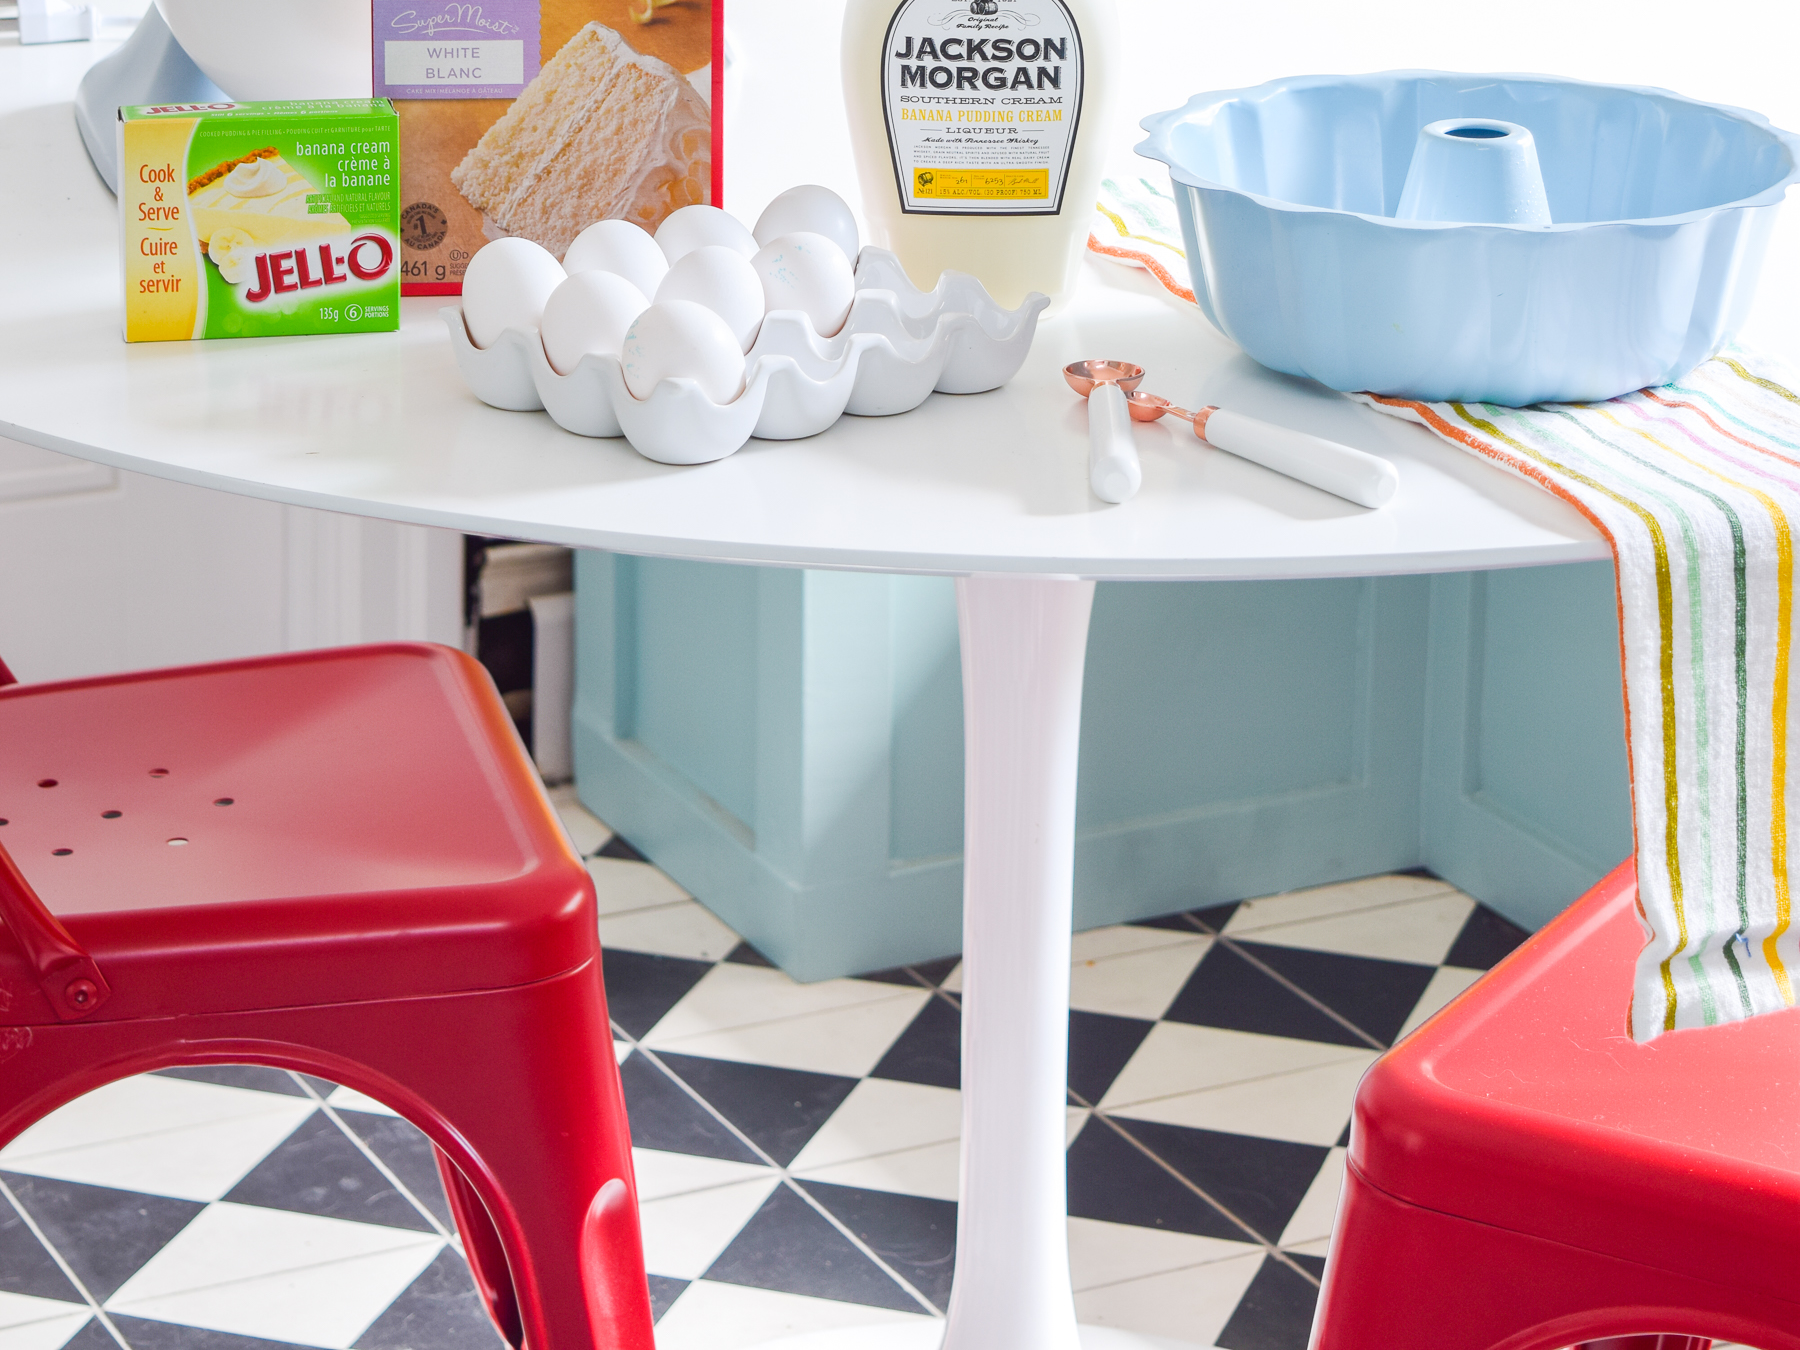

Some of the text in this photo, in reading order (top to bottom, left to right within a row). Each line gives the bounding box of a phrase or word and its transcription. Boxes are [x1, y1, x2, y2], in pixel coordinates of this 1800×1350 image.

[967, 16, 998, 24] Original
[427, 47, 480, 59] WHITE
[895, 36, 1067, 63] JACKSON
[425, 67, 482, 79] BLANC
[900, 64, 1062, 91] MORGAN
[900, 95, 1063, 105] SOUTHERN CREAM
[146, 103, 235, 115] JELL-O
[901, 108, 1063, 123] BANANA PUDDING CREAM
[945, 127, 1019, 135] LIQUEUR
[296, 141, 390, 156] banana cream
[337, 155, 390, 171] crème à
[139, 163, 175, 183] Cook
[325, 173, 390, 188] la banane
[154, 186, 164, 202] &
[345, 193, 368, 202] NATURAL
[368, 192, 391, 201] FLAVOUR
[138, 202, 180, 221] Serve
[359, 203, 365, 212] ET
[366, 202, 391, 211] NATURELS
[401, 203, 439, 220] CANADA'S
[140, 237, 178, 256] Cuire
[404, 238, 416, 247] AU
[417, 230, 446, 250] CANADA
[153, 260, 166, 274] et
[246, 232, 393, 303] JELL-O
[401, 260, 446, 280] 461 g
[139, 275, 181, 293] servir
[319, 307, 339, 322] 135g
